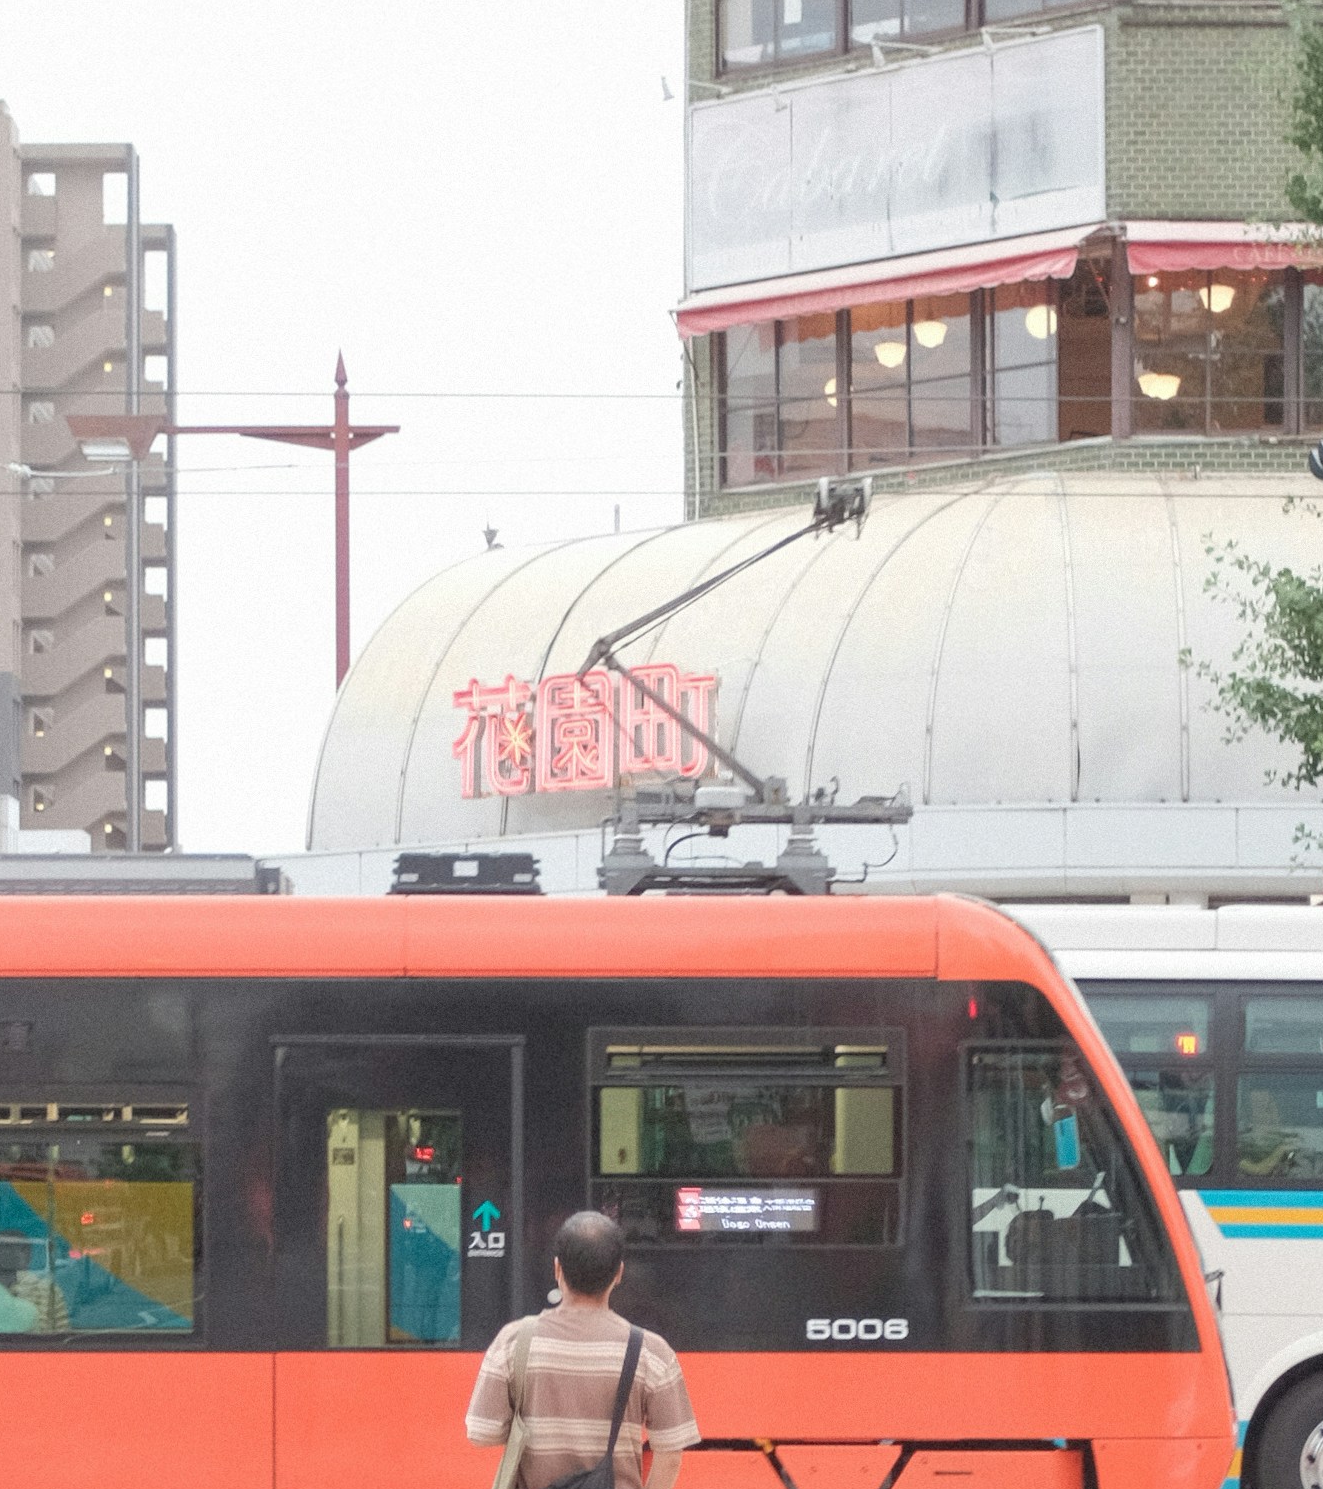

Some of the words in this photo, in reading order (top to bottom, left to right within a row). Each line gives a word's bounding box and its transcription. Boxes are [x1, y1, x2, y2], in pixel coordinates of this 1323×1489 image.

[452, 662, 717, 799] 花園町
[467, 1231, 505, 1249] 入口
